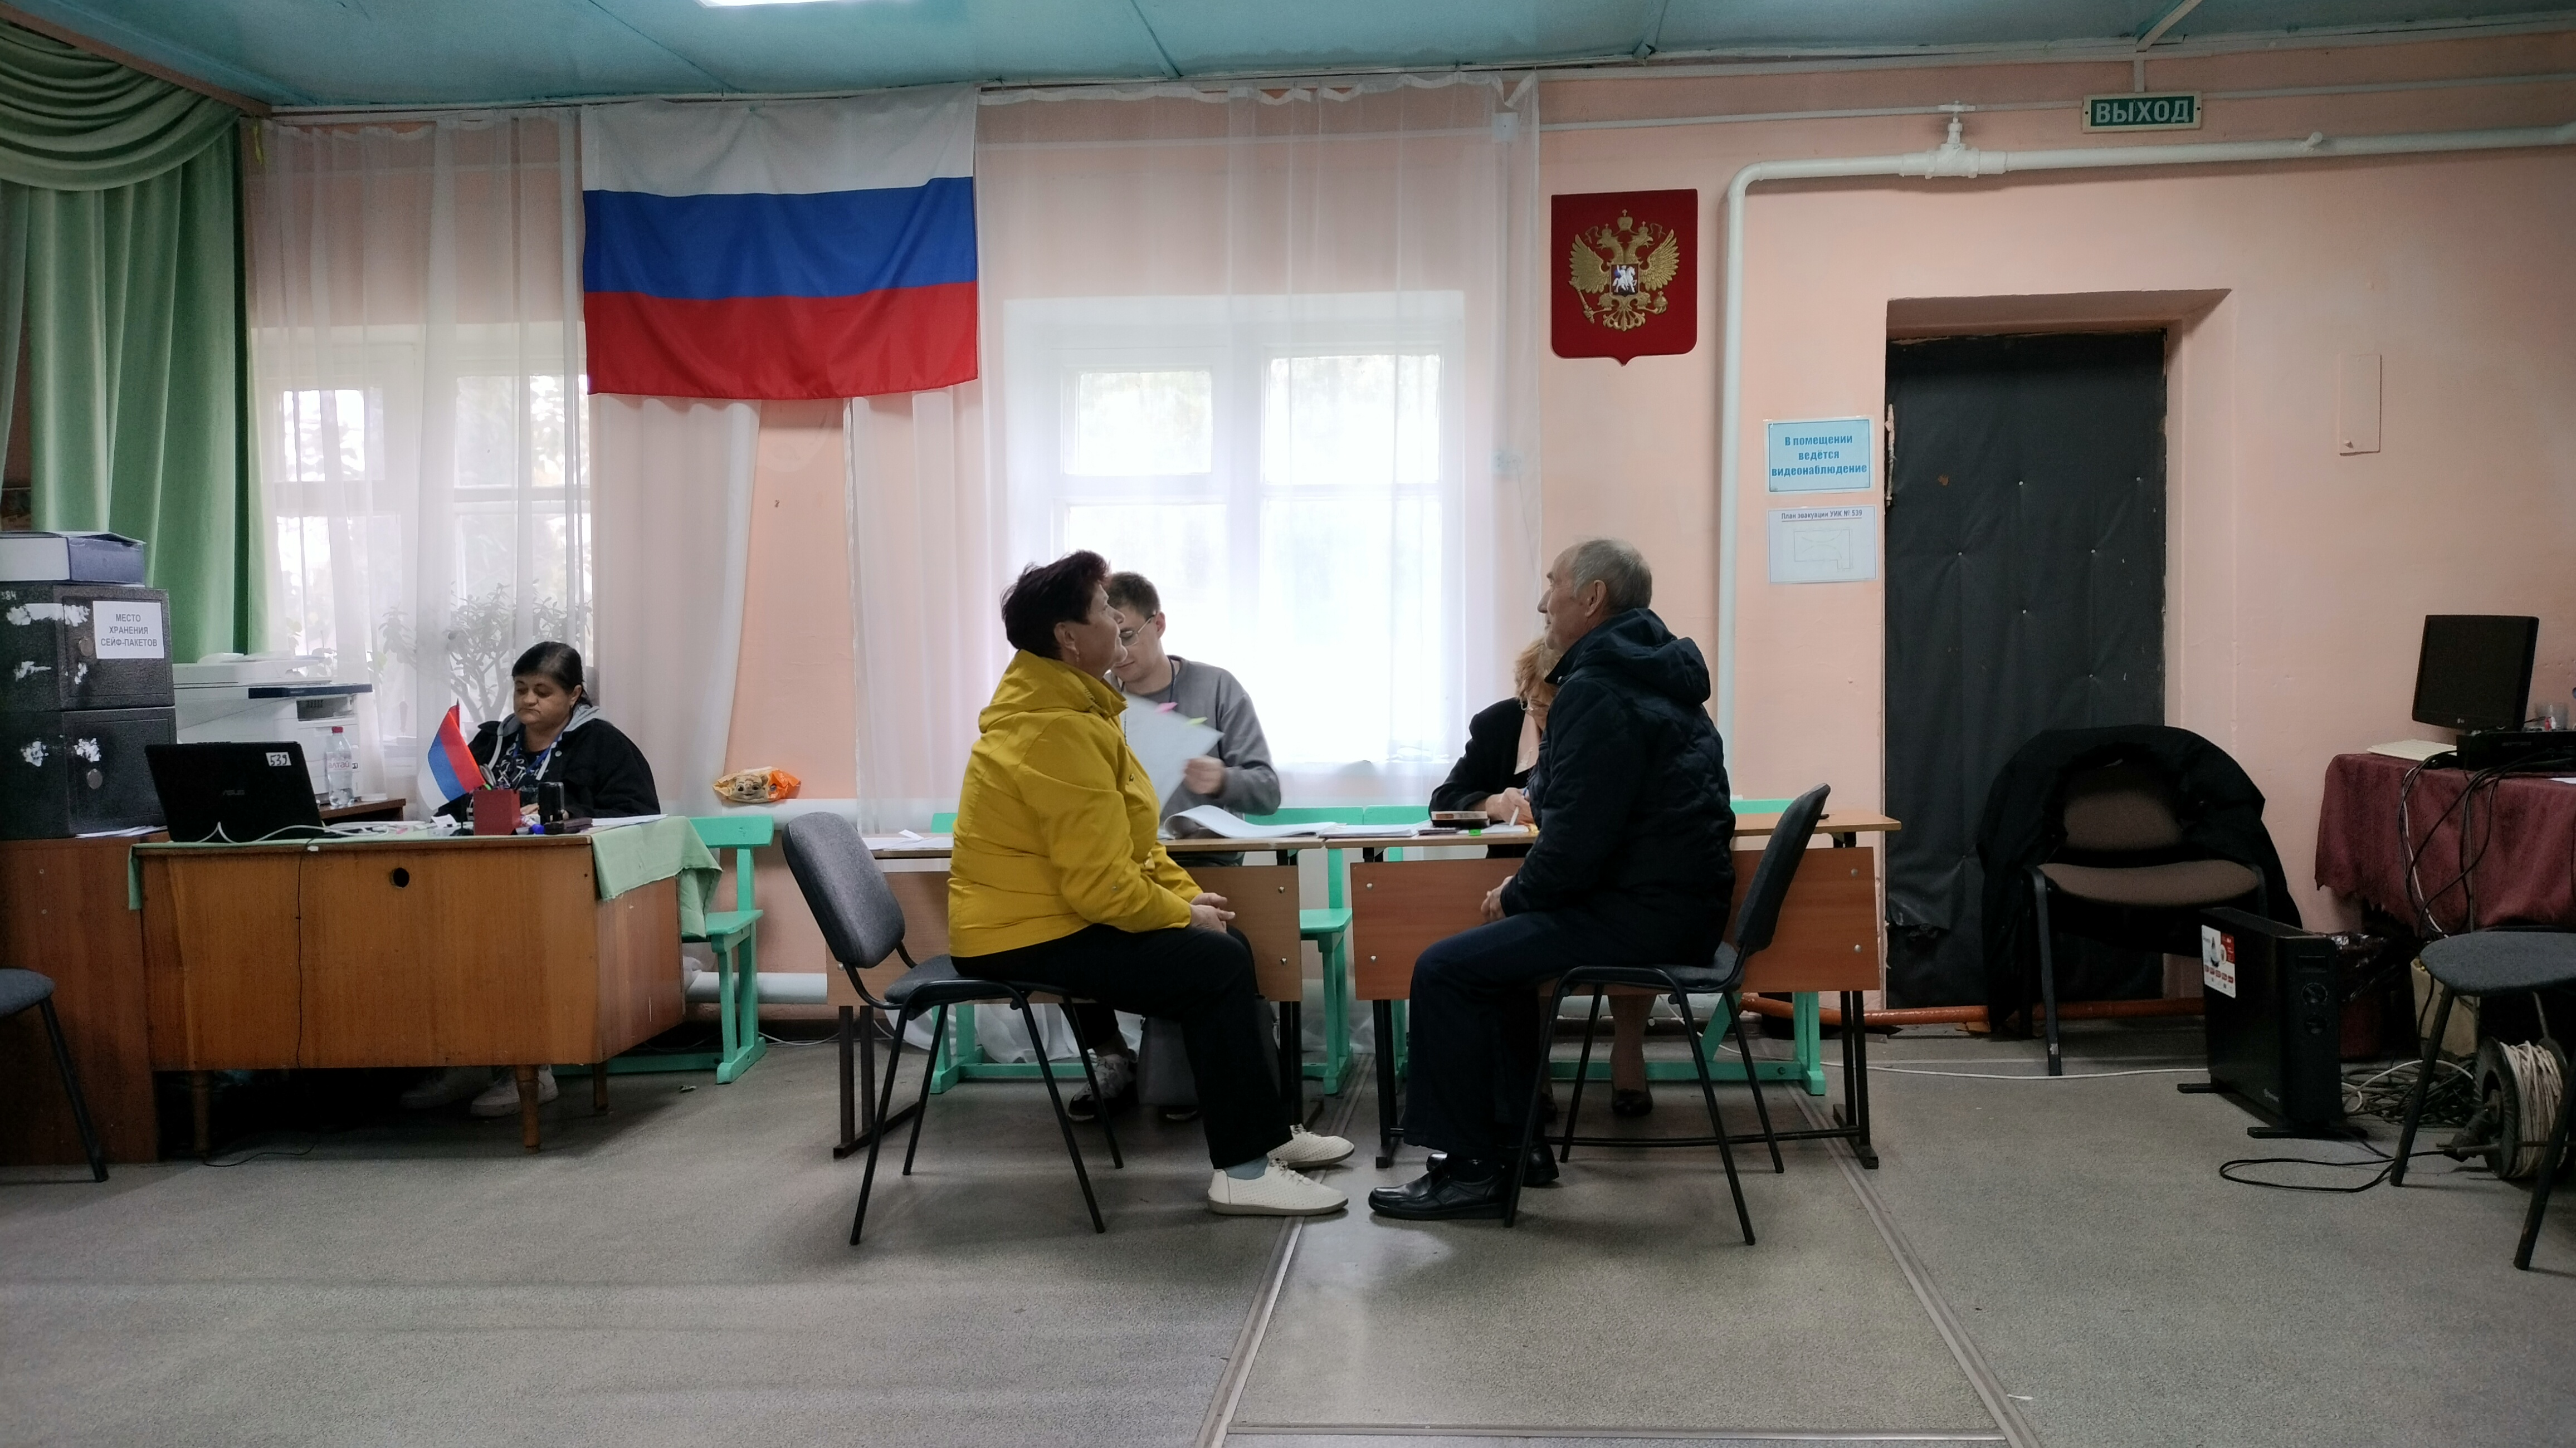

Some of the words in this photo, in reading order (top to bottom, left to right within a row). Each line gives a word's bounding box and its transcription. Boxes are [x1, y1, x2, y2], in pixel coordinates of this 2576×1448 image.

[2096, 100, 2189, 123] ВЫХОД
[1785, 437, 1790, 446] В
[1793, 435, 1853, 446] помещении
[1798, 450, 1840, 461] ведётся
[1771, 464, 1867, 478] видеонаблюдение
[116, 614, 141, 622] МЕСТО
[109, 626, 148, 634] ХРАНЕНИЯ
[101, 637, 157, 647] СЕЙФ-ПАКЕТОВ
[270, 754, 287, 766] 539
